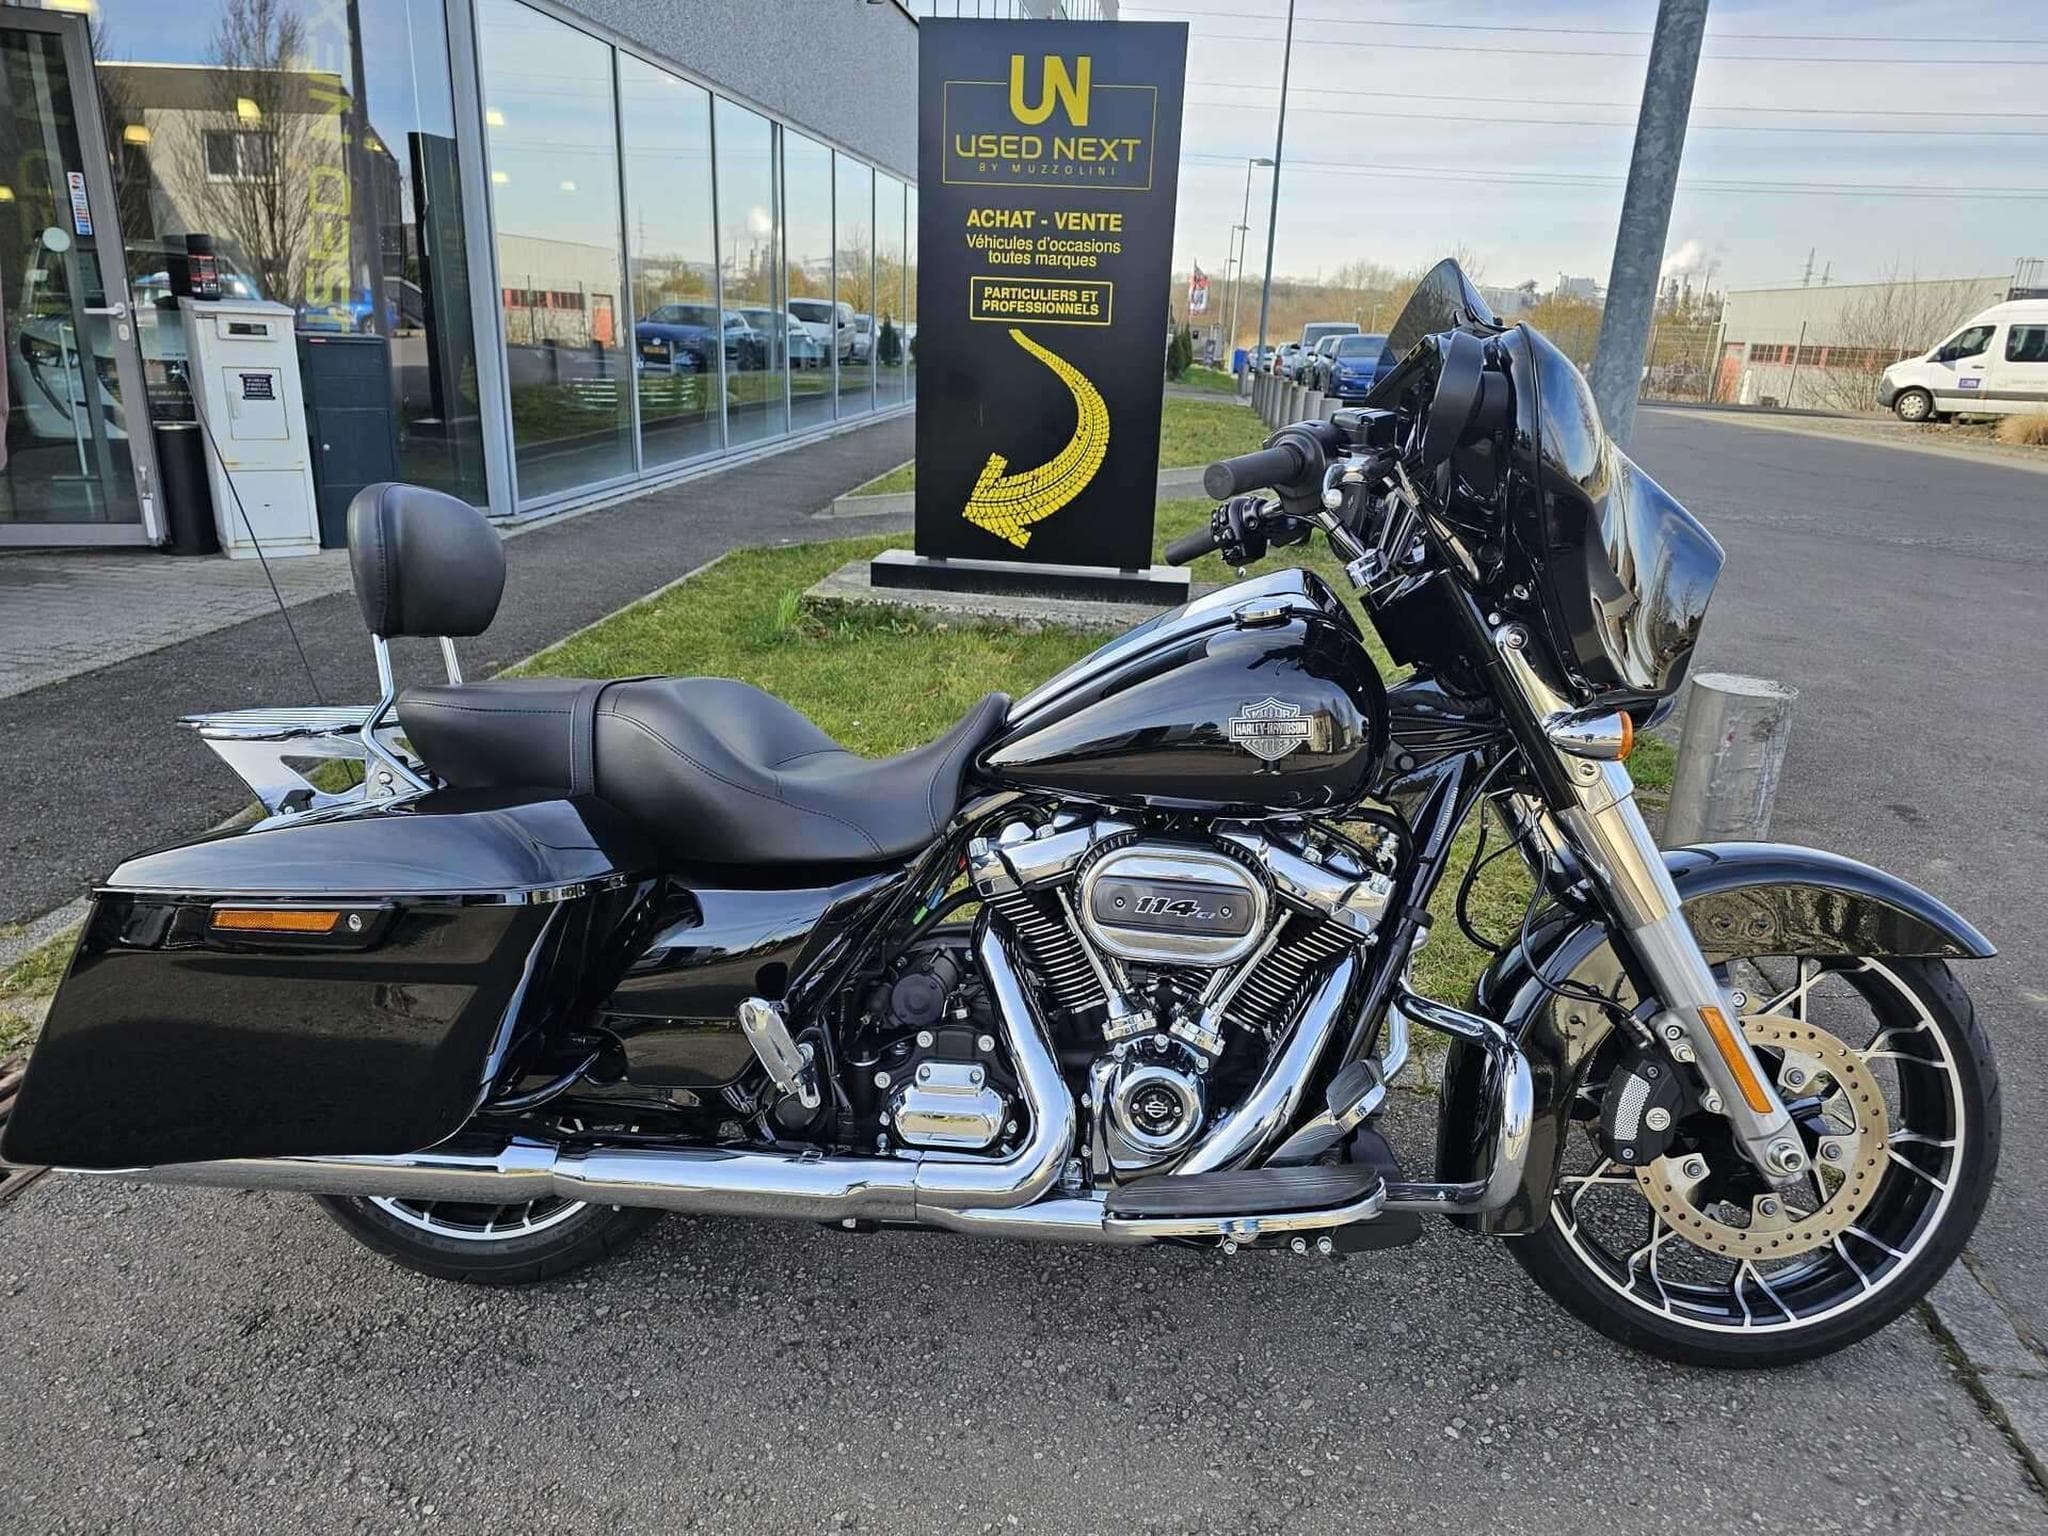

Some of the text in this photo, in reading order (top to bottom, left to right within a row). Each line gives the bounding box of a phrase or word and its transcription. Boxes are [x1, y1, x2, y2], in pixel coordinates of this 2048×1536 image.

[1010, 54, 1091, 126] UN
[955, 134, 1142, 162] USED NEXT
[978, 162, 1115, 176] BY MUZZOLINI
[966, 208, 1036, 228] ACHAT
[1054, 211, 1123, 232] VENTE
[966, 233, 1121, 254] Véhicules d'occasions
[988, 250, 1097, 269] toutes marques
[984, 286, 1098, 302] PARTICULIERS ET
[982, 299, 1099, 315] PROFESSIONNELS
[1235, 721, 1307, 735] HARLEY-DAVIDSON
[1135, 895, 1200, 917] 114
